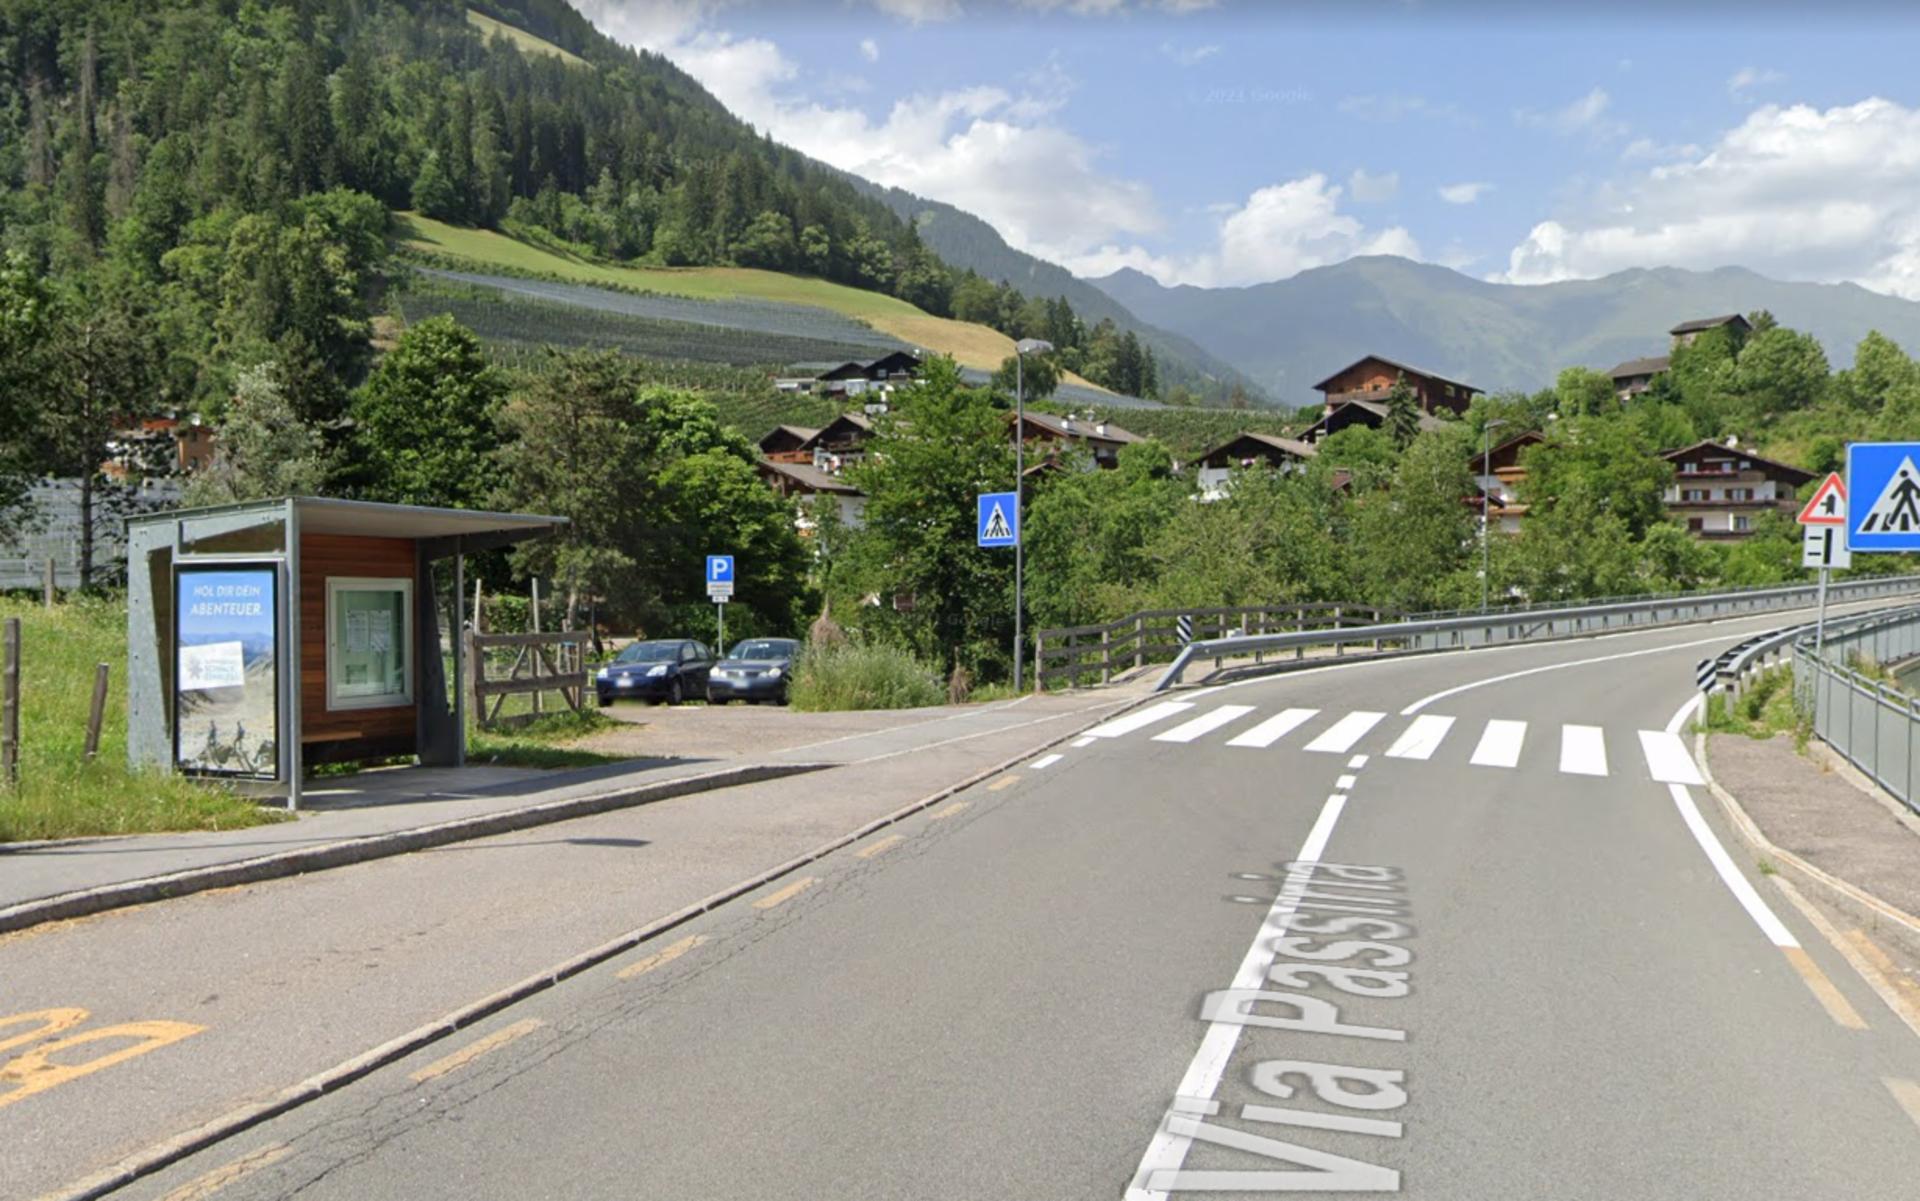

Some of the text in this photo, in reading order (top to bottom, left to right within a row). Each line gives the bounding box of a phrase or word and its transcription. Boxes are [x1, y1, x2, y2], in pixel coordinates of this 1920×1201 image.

[712, 559, 729, 580] P
[193, 584, 262, 598] HOL DIR DEIN
